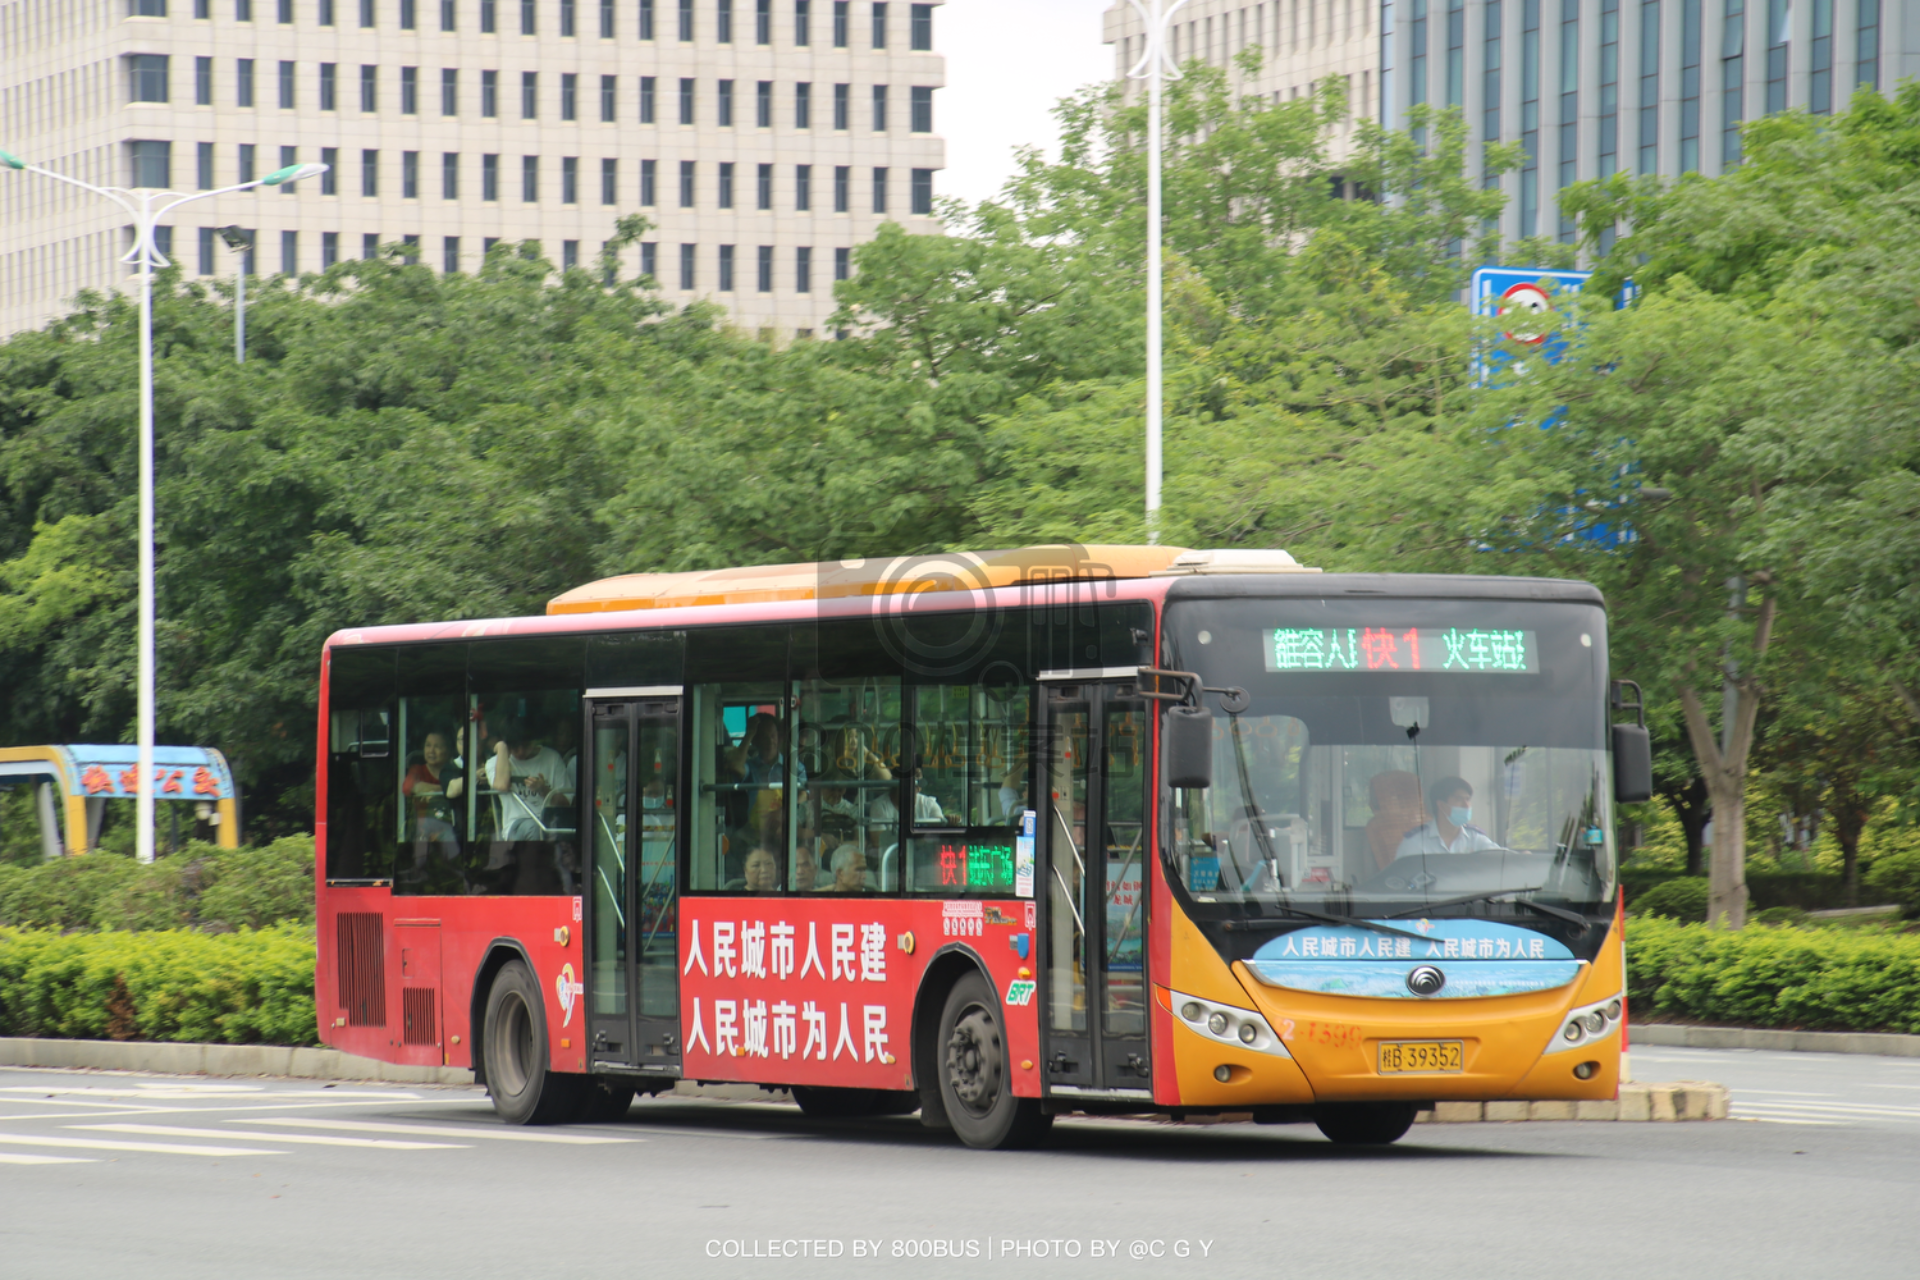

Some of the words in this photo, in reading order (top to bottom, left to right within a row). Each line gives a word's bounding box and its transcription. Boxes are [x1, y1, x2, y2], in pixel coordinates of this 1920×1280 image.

[684, 919, 887, 982] 人民城市人民建
[1282, 936, 1412, 958] 人民城市人民建
[1425, 937, 1545, 959] 人民城市为人民
[1006, 980, 1036, 1005] BRT
[686, 996, 889, 1065] 人民城市为人民
